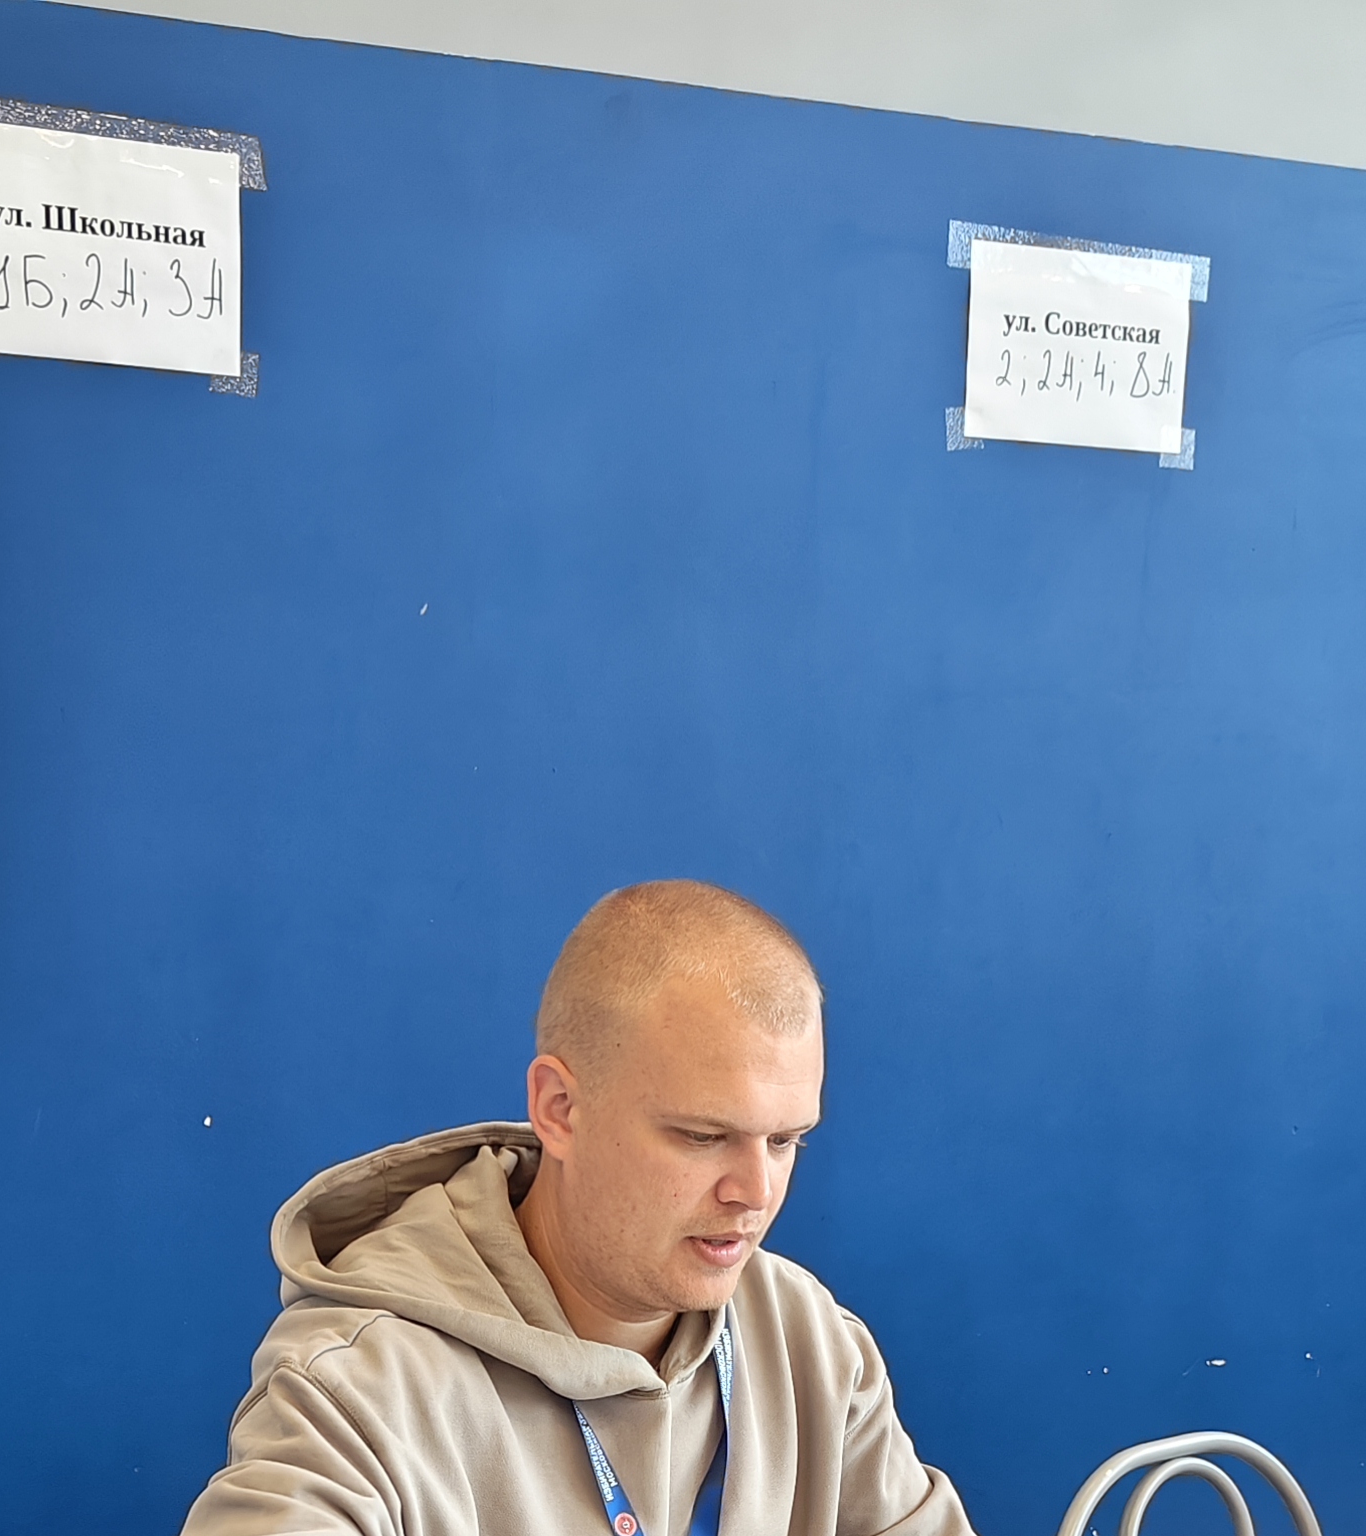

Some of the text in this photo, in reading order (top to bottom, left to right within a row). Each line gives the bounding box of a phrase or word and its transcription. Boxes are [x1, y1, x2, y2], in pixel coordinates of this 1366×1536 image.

[42, 204, 206, 248] Школьная
[1003, 312, 1161, 345] ул. Советская
